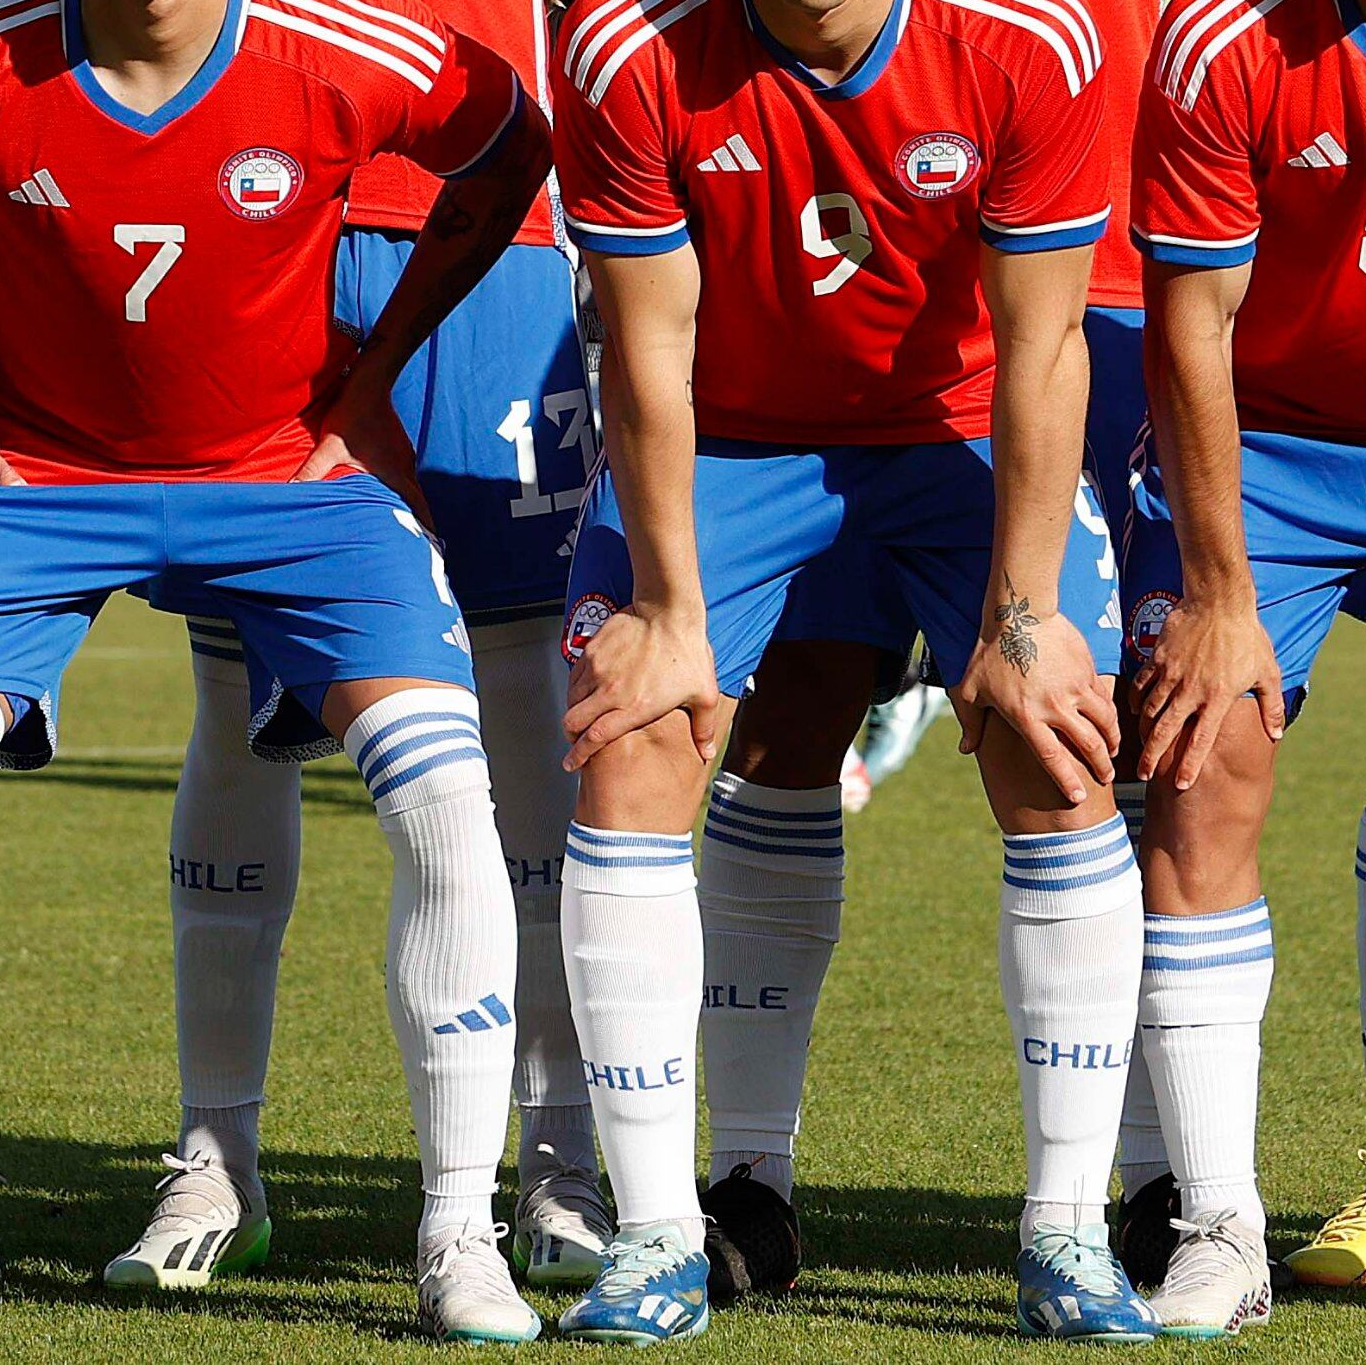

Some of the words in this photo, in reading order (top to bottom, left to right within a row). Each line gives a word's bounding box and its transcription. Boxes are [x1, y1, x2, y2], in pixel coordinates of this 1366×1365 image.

[901, 136, 931, 160] COMITE
[935, 135, 973, 159] OLIMPICO
[224, 151, 254, 178] COMITE
[258, 150, 297, 179] OLIMPICO
[918, 188, 954, 198] CHILE
[241, 207, 277, 218] CHILE
[800, 193, 872, 296] 9
[114, 224, 185, 322] 7
[496, 388, 597, 518] 13
[170, 854, 265, 894] HILE
[704, 985, 790, 1010] HILE
